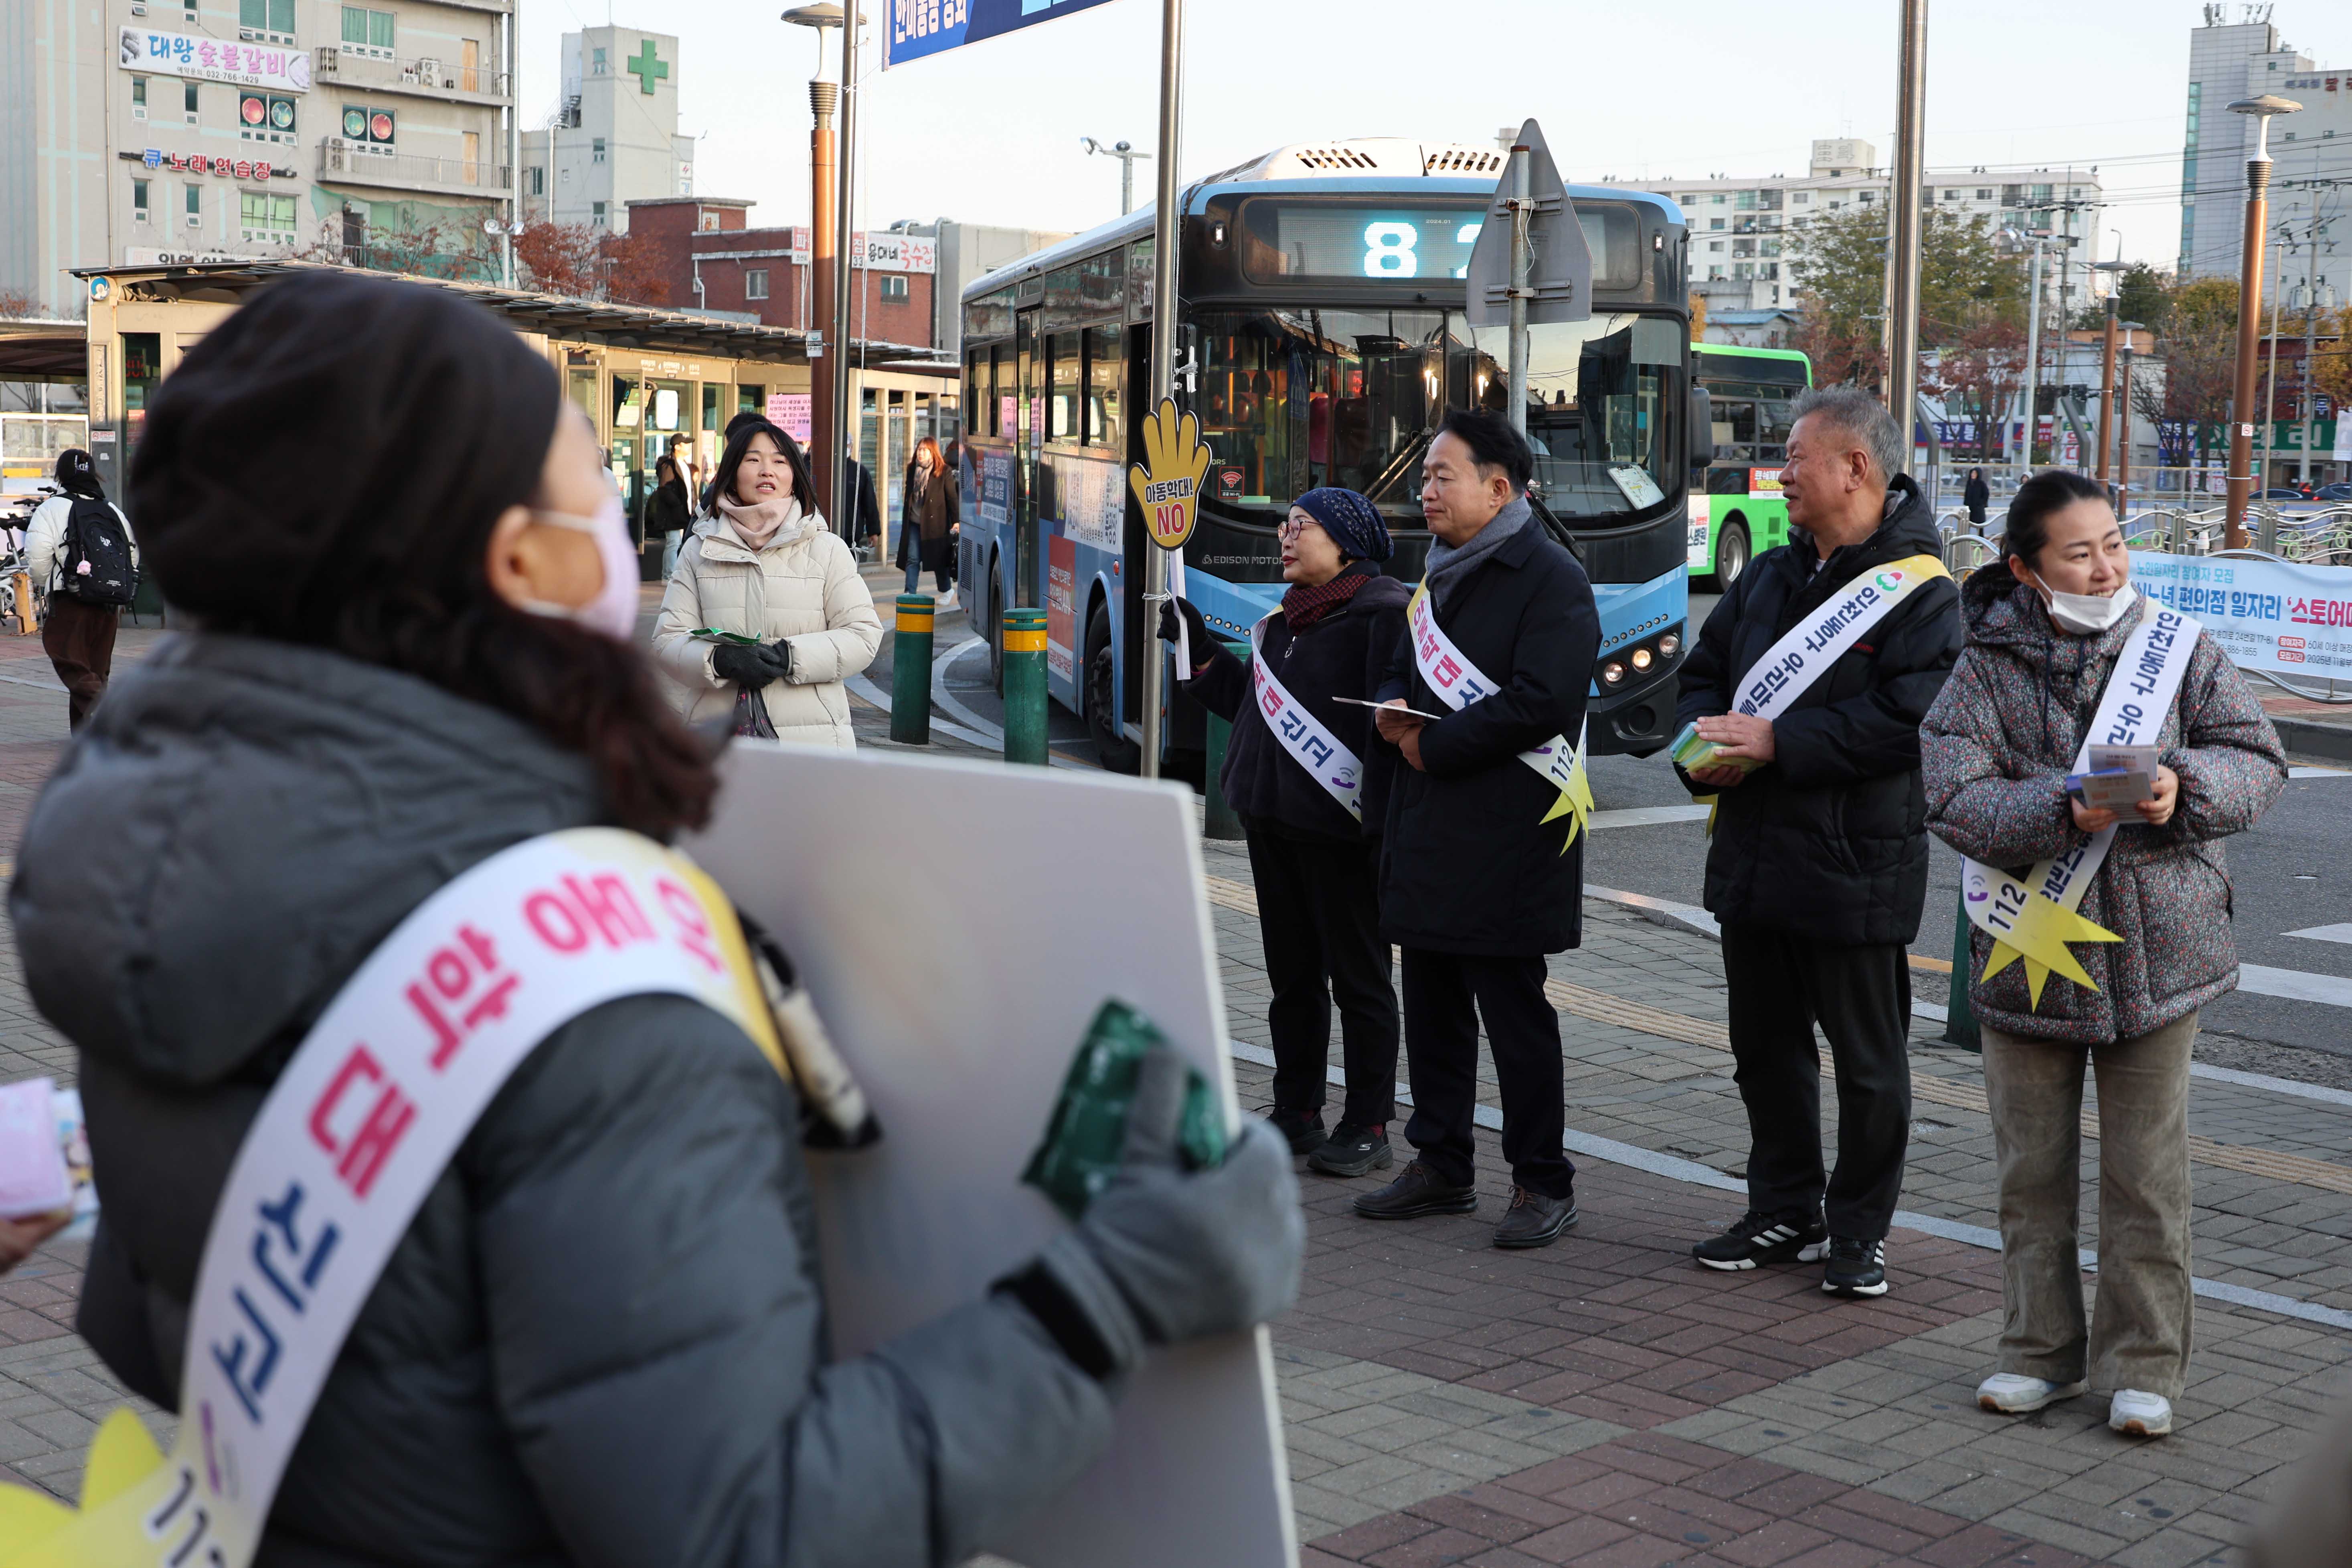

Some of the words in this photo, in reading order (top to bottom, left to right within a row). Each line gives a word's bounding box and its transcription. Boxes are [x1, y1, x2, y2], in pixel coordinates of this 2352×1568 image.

[148, 34, 194, 63] 대왕
[198, 40, 285, 77] 숯불갈비
[143, 148, 162, 168] 큐
[1144, 280, 1154, 306] 628
[1146, 477, 1193, 504] 아동학대!
[1157, 504, 1185, 536] NO
[1251, 556, 1283, 564] MOTOR
[2137, 561, 2179, 579] 노인일자리
[2182, 566, 2211, 582] 참여자
[2214, 568, 2234, 584] 모집
[1804, 586, 1880, 654] 인천동구
[2179, 587, 2225, 615] 편의점
[2231, 591, 2281, 621] 일자리
[1414, 599, 1463, 688] 아동학대
[2130, 611, 2183, 696] 인천동구
[2235, 632, 2255, 642] 24번길
[2280, 637, 2304, 648] 참여자격
[2308, 641, 2323, 649] 60세
[2325, 642, 2338, 652] 이상
[2279, 651, 2303, 662] 모집기간
[2307, 654, 2331, 665] 2025년
[1280, 710, 1334, 768] 신고
[1550, 745, 1575, 782] 112
[1988, 883, 2027, 930] 112
[307, 871, 727, 1200] 아동학대
[210, 1181, 342, 1425] 신고
[154, 1468, 227, 1568] 11
